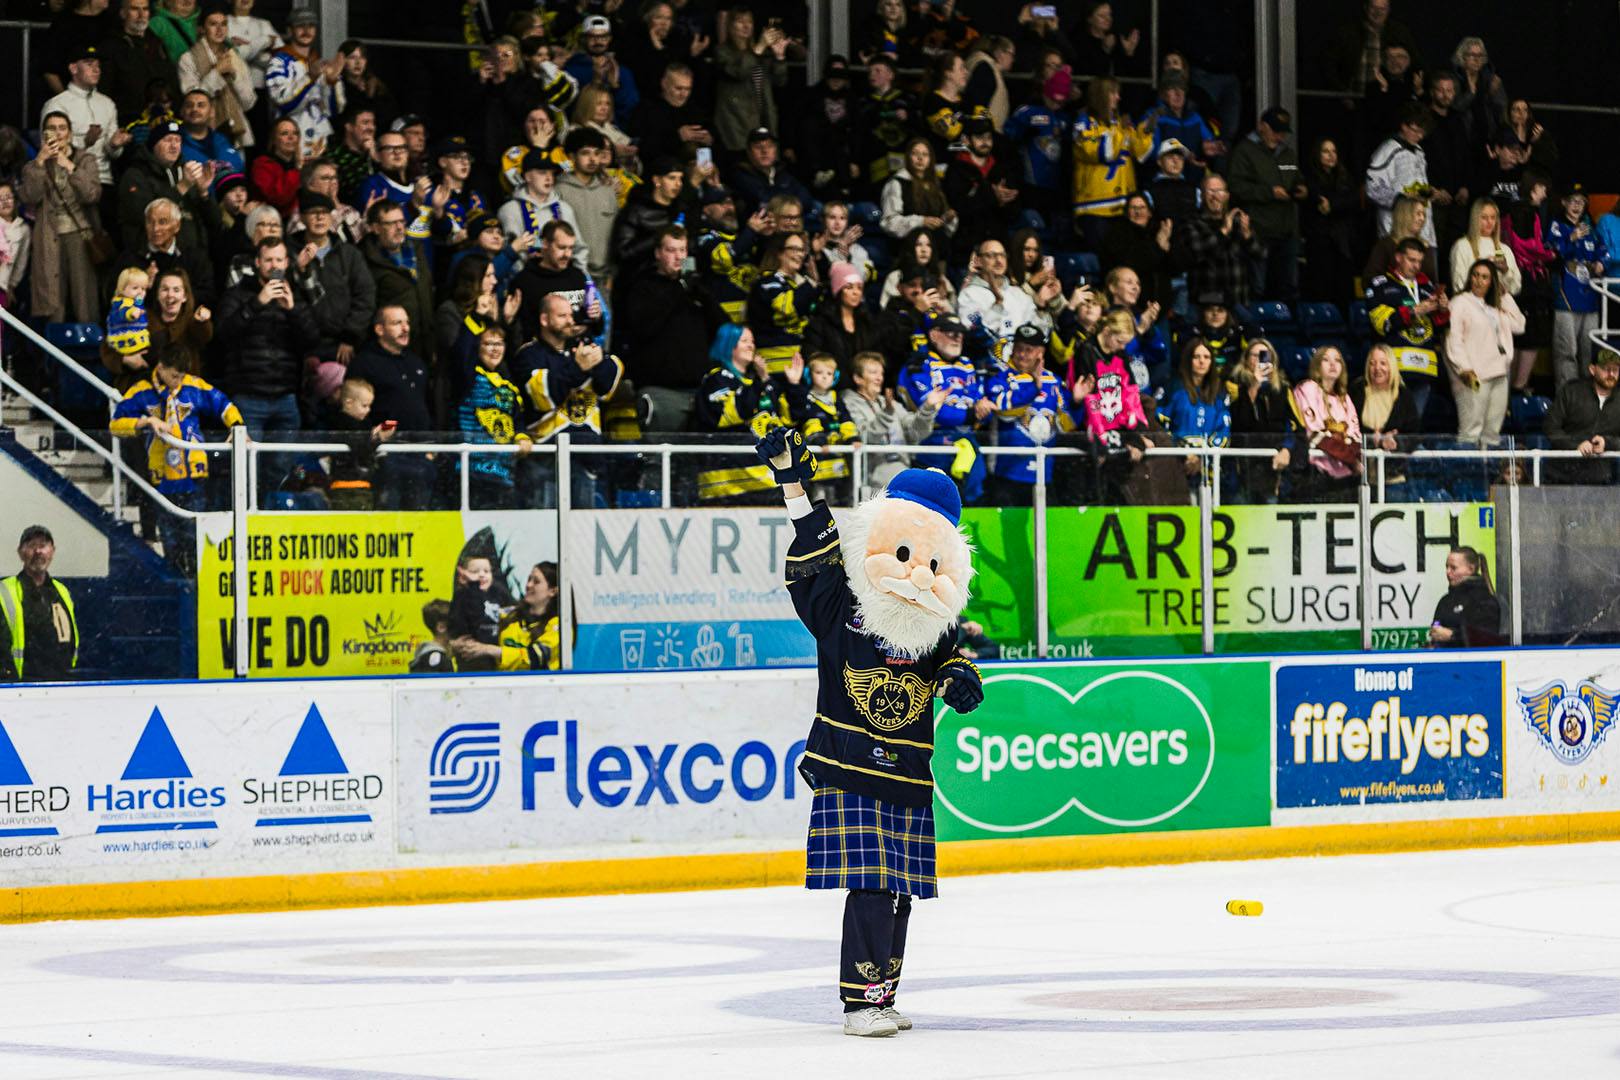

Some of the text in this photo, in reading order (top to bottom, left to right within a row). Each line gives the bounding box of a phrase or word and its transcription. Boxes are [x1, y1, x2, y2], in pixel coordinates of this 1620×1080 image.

[279, 534, 358, 560] STATIONS
[366, 532, 414, 558] DON'T
[594, 517, 787, 575] MYRT
[1083, 509, 1459, 580] ARB-TECH
[219, 567, 429, 597] GIE A PUCK ABOUT FIFE.
[1136, 587, 1230, 627] TREE
[219, 614, 330, 670] WE DO
[884, 683, 904, 694] FIFE
[1354, 667, 1414, 692] Home of
[876, 698, 886, 706] 19
[873, 712, 902, 726] FLYERS
[1290, 696, 1490, 775] fifeflyers
[956, 726, 1188, 782] Specsavers
[87, 780, 226, 812] Hardies
[242, 775, 383, 805] SHEPHERD
[1339, 781, 1445, 800] www.fifeflyers.co.uk
[103, 839, 209, 853] www.hardies.co.uk
[252, 832, 376, 848] www.shepherd.co.uk
